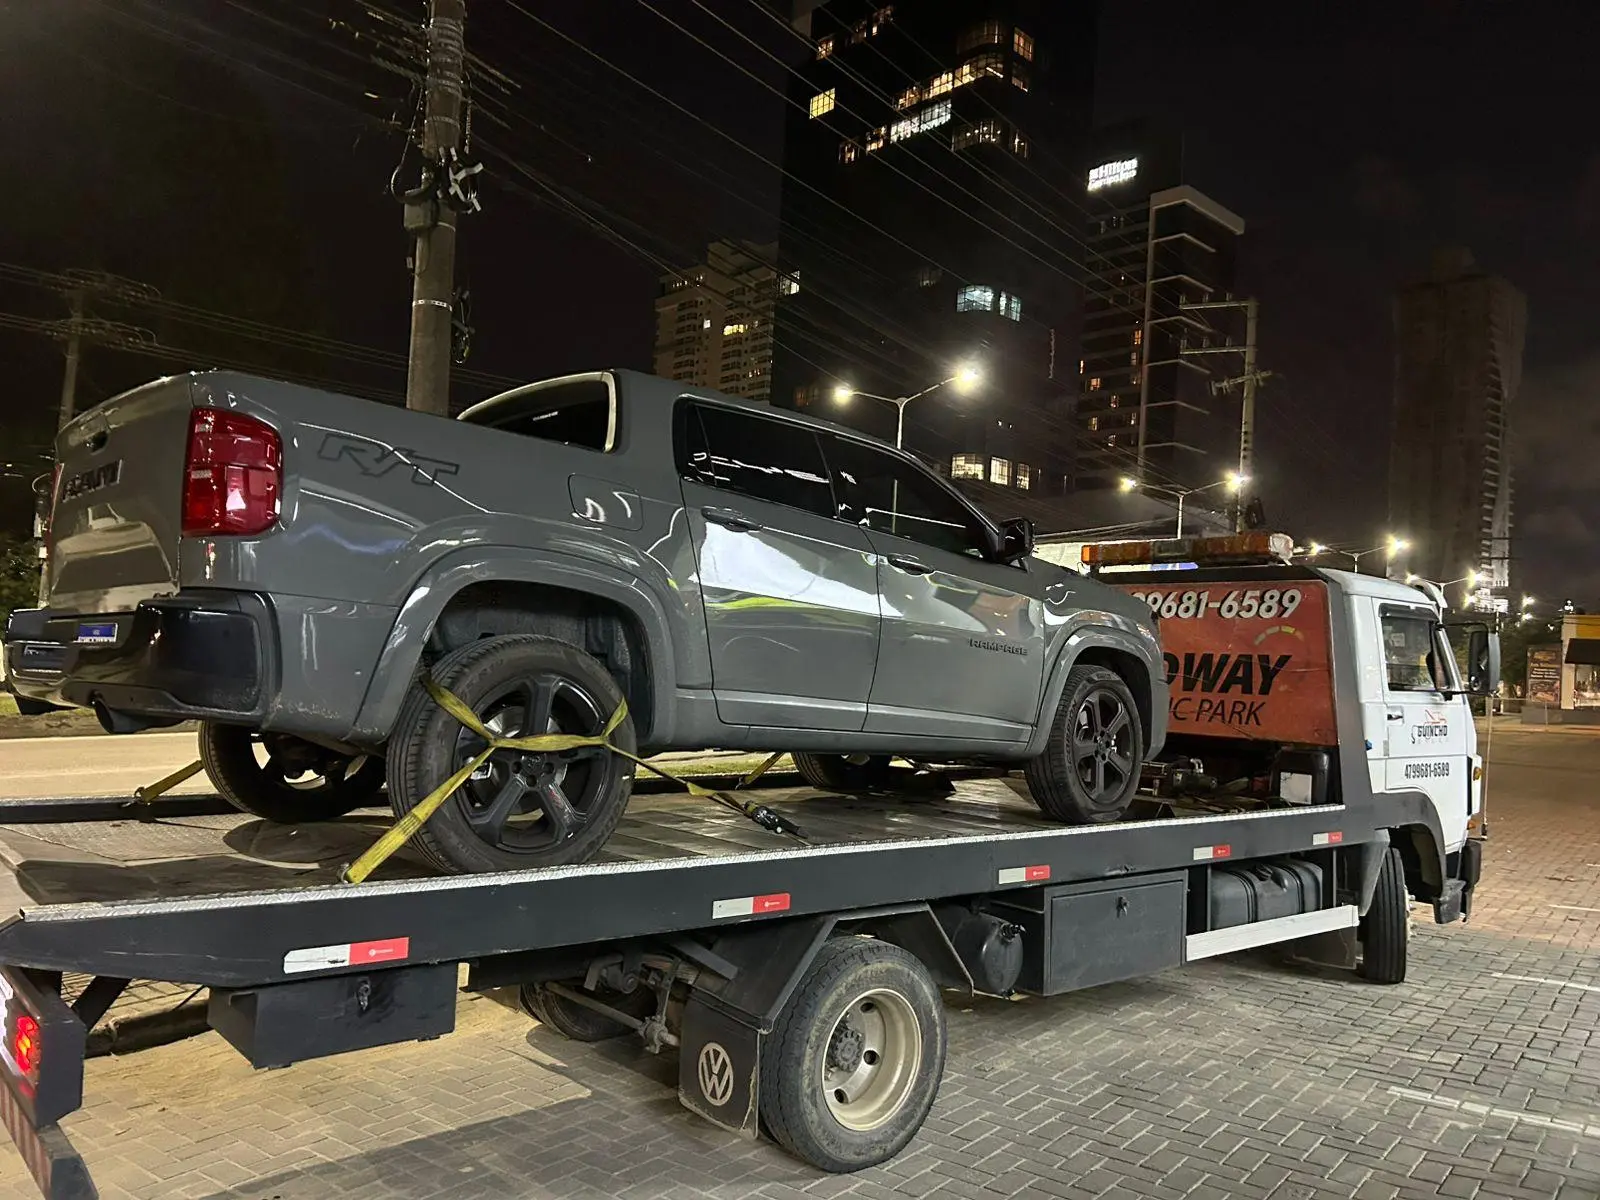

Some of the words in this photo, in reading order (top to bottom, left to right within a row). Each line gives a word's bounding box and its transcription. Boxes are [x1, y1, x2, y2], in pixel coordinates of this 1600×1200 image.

[317, 433, 460, 486] R/T
[969, 638, 1029, 656] RAMPAGE
[1196, 699, 1266, 726] PARK
[1405, 761, 1449, 779] 4799681-6589
